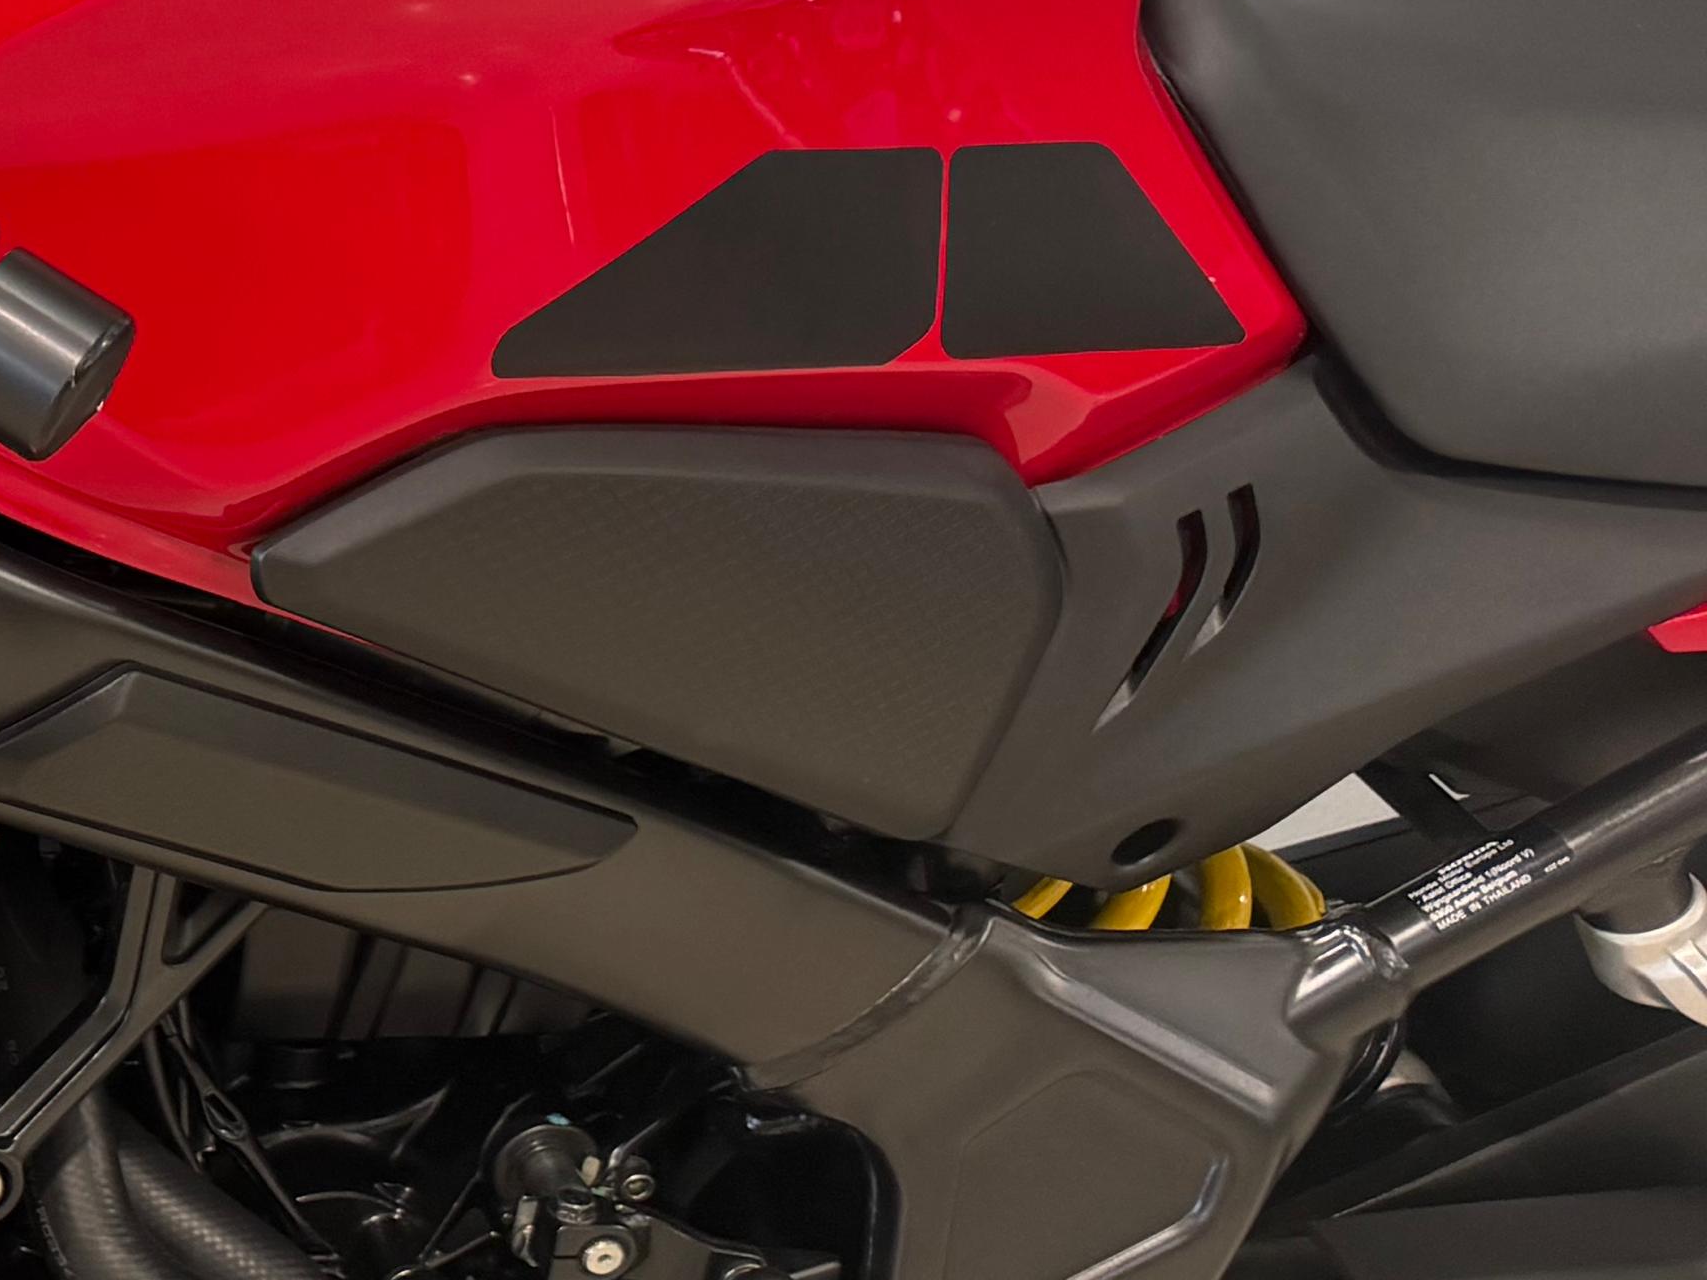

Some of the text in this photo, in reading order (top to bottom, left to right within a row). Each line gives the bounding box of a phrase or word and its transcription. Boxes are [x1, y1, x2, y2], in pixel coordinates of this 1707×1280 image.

[1437, 874, 1532, 930] MADE IN THAILAND
